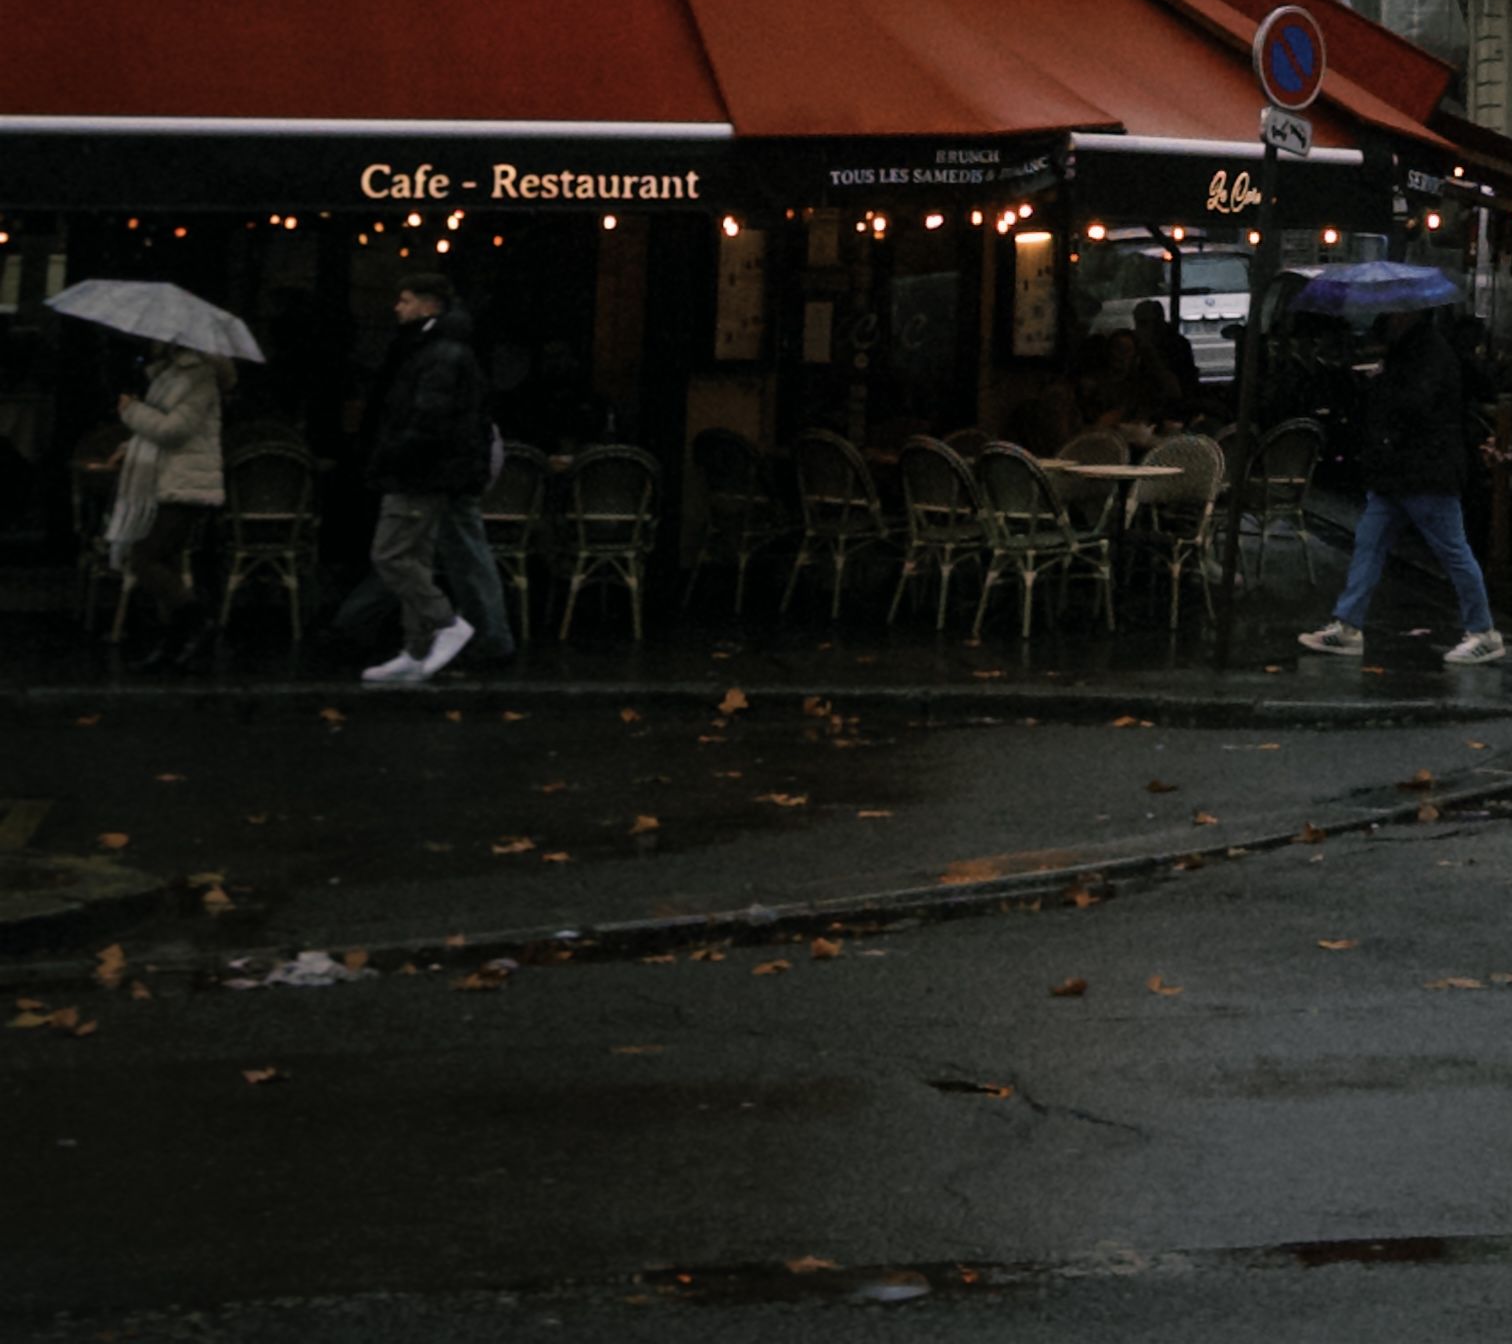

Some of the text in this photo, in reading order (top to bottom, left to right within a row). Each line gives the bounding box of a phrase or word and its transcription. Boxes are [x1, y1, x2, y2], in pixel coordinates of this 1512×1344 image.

[936, 149, 1000, 164] BRUNCH
[360, 164, 450, 199] Cafe
[490, 164, 700, 200] Restaurant
[830, 169, 875, 186] TOUS
[879, 168, 910, 184] LES
[913, 168, 984, 184] SAMEDIS
[1206, 170, 1231, 214] Le
